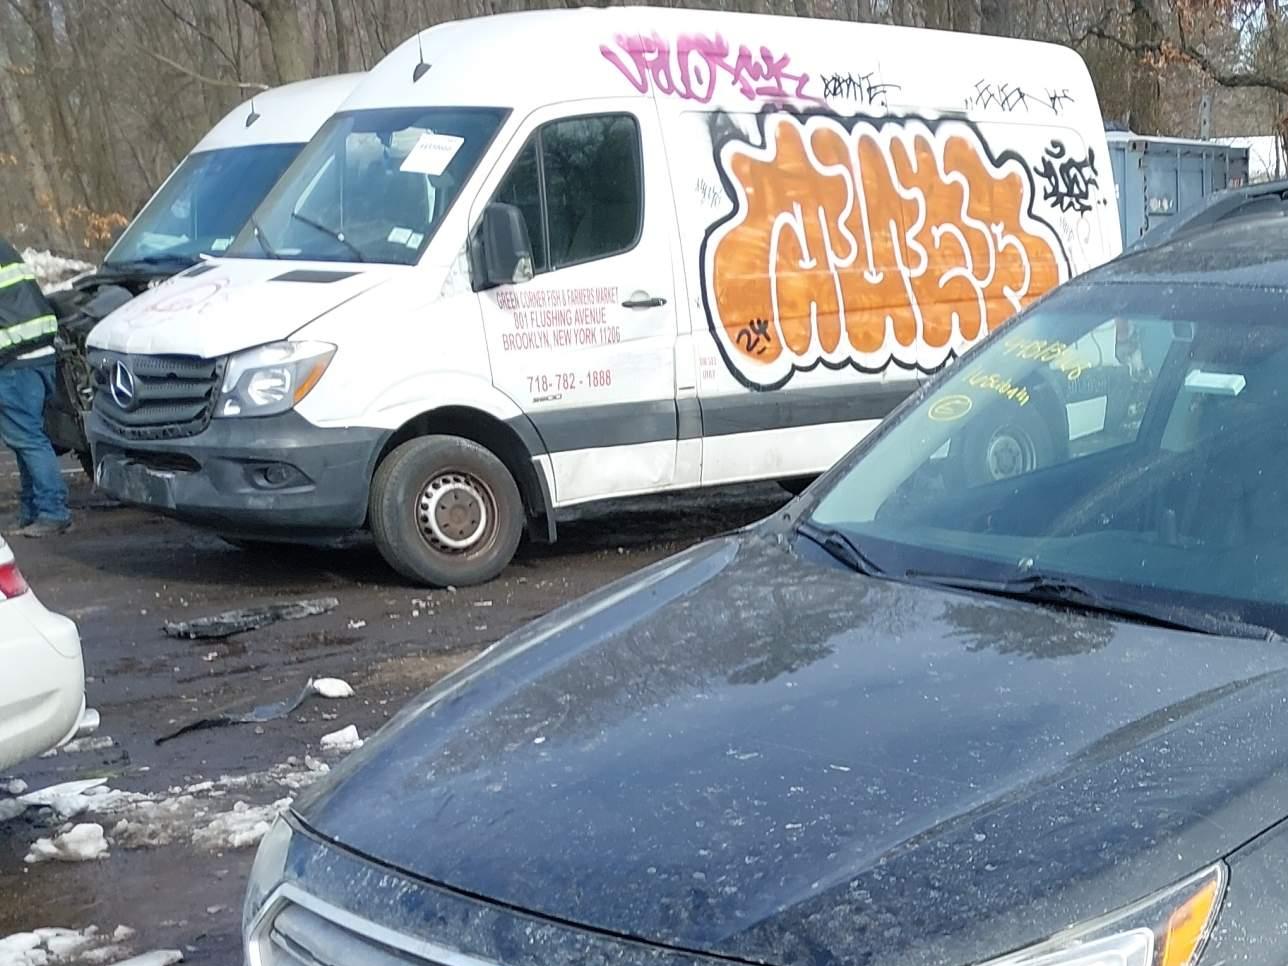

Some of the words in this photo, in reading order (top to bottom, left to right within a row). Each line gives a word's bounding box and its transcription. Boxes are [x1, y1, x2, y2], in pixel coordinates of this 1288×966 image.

[496, 290, 521, 310] GREEN
[521, 289, 546, 309] CORNER
[547, 288, 561, 307] FISH
[567, 287, 595, 306] FARMERS
[595, 286, 619, 305] MARKET
[530, 309, 573, 329] FLUSHING
[574, 307, 607, 326] AVENUE
[502, 330, 553, 351] BROOKLYN,
[553, 328, 574, 348] NEW
[574, 327, 598, 345] YORK
[599, 326, 621, 344] 11206
[737, 317, 771, 353] 24
[555, 372, 576, 391] 782
[587, 369, 612, 388] 1888
